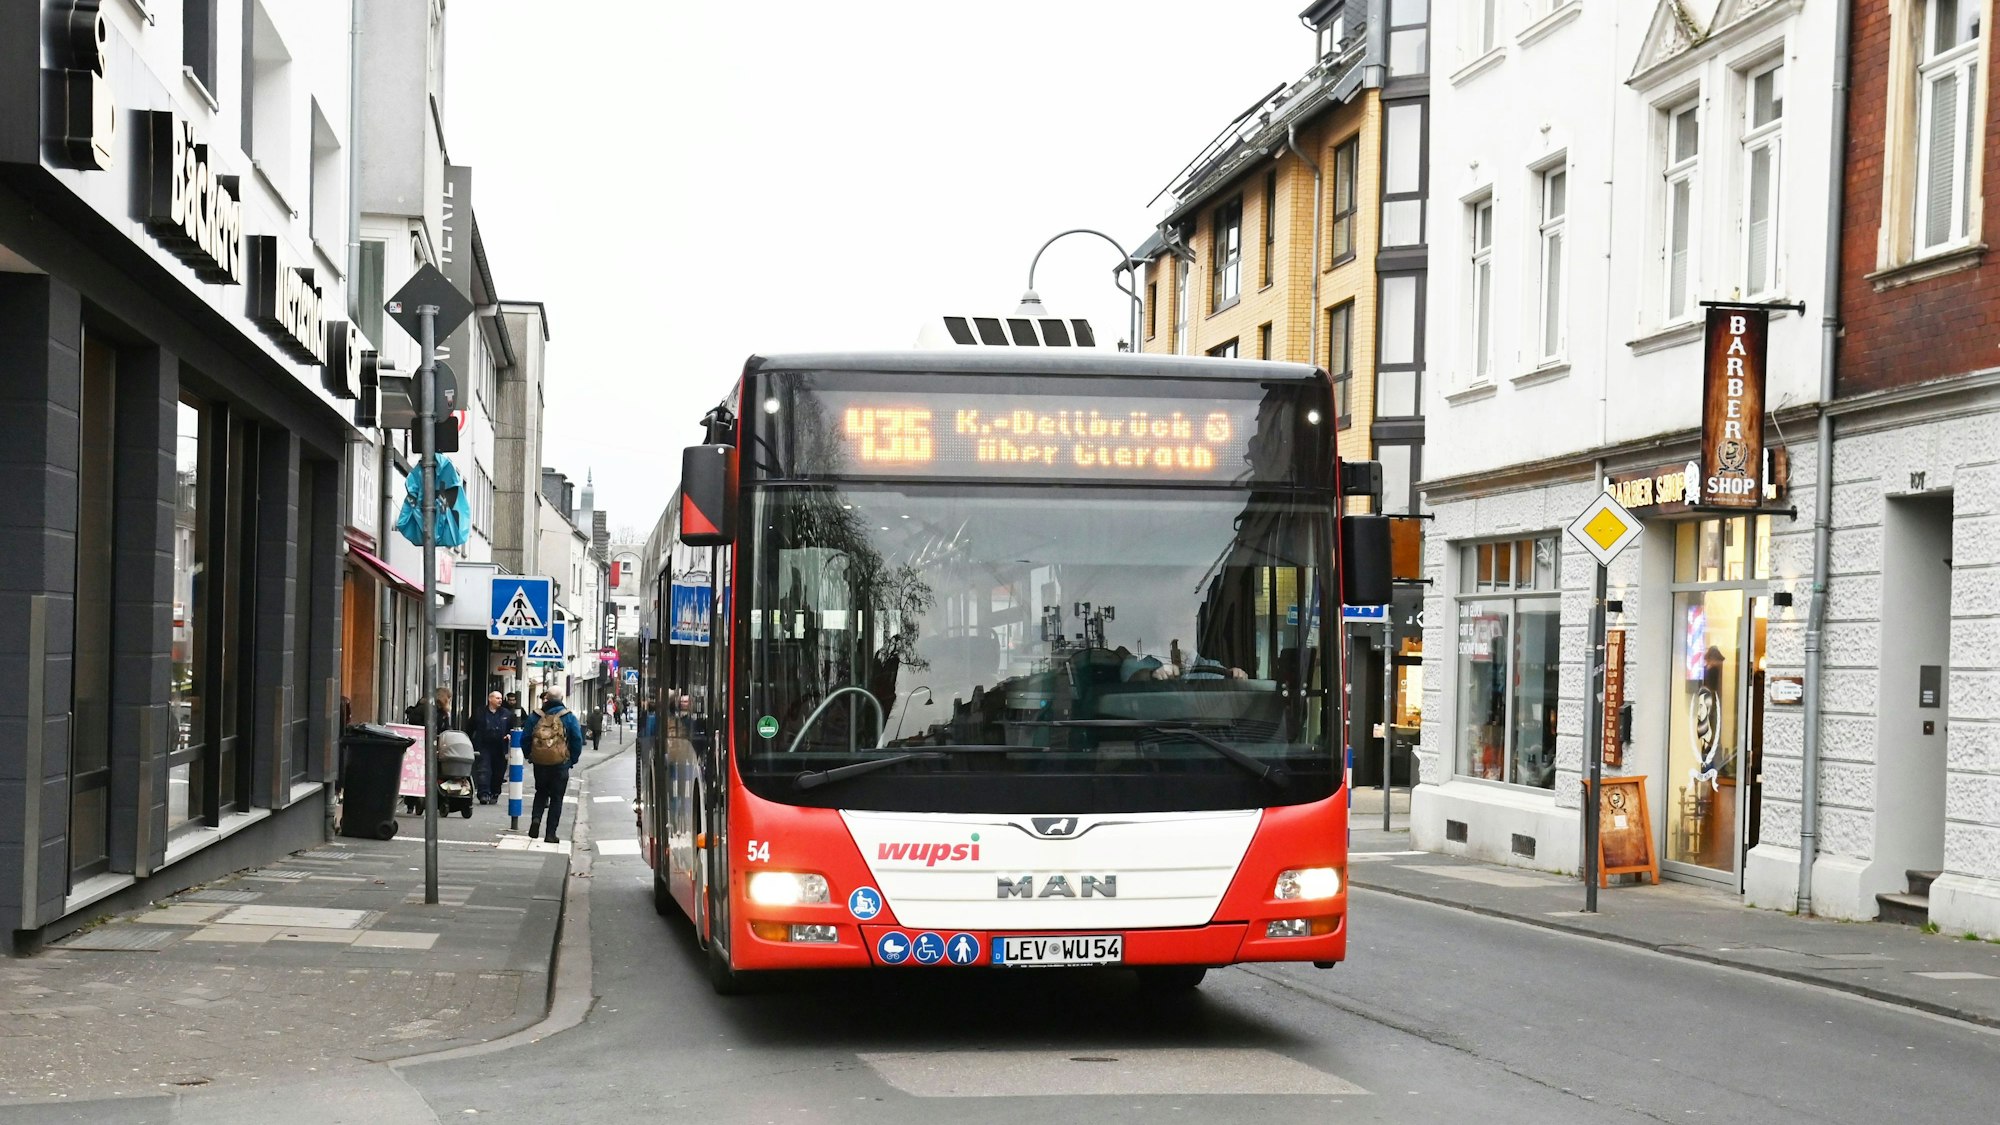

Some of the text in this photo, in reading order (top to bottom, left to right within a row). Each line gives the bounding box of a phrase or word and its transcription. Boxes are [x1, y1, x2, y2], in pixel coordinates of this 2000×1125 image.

[1725, 315, 1747, 439] BARBER
[1656, 471, 1686, 504] SHOP
[1706, 476, 1756, 495] SHOP
[747, 840, 770, 863] 54
[877, 832, 980, 867] wupsi
[996, 874, 1117, 898] MAN
[1006, 940, 1047, 961] LEV
[1062, 939, 1089, 959] WU
[1094, 938, 1119, 959] 54
